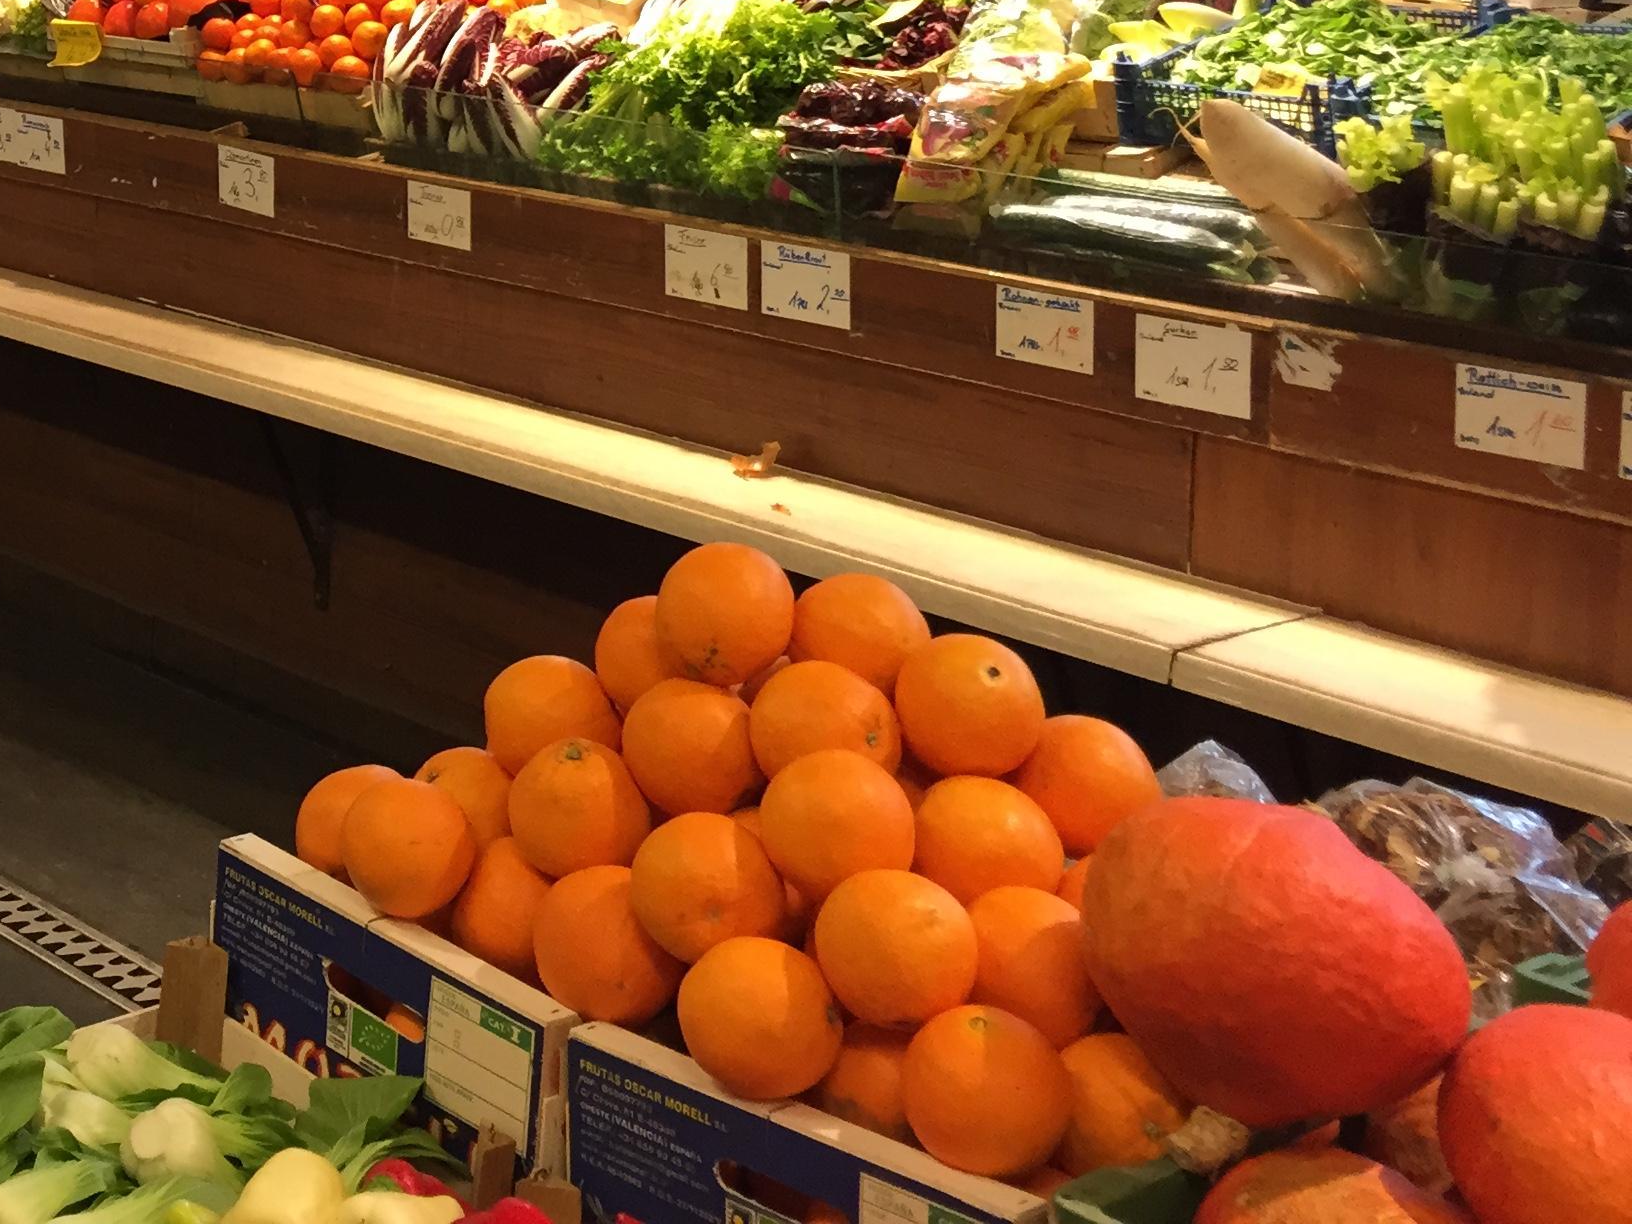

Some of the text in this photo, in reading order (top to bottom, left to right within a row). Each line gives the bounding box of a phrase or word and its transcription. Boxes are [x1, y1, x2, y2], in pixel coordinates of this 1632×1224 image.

[225, 866, 323, 929] FRUTAS OSCAR MORELL
[579, 1059, 621, 1087] FRUTAS
[624, 1079, 662, 1105] OSCAR
[664, 1095, 712, 1126] MORELL
